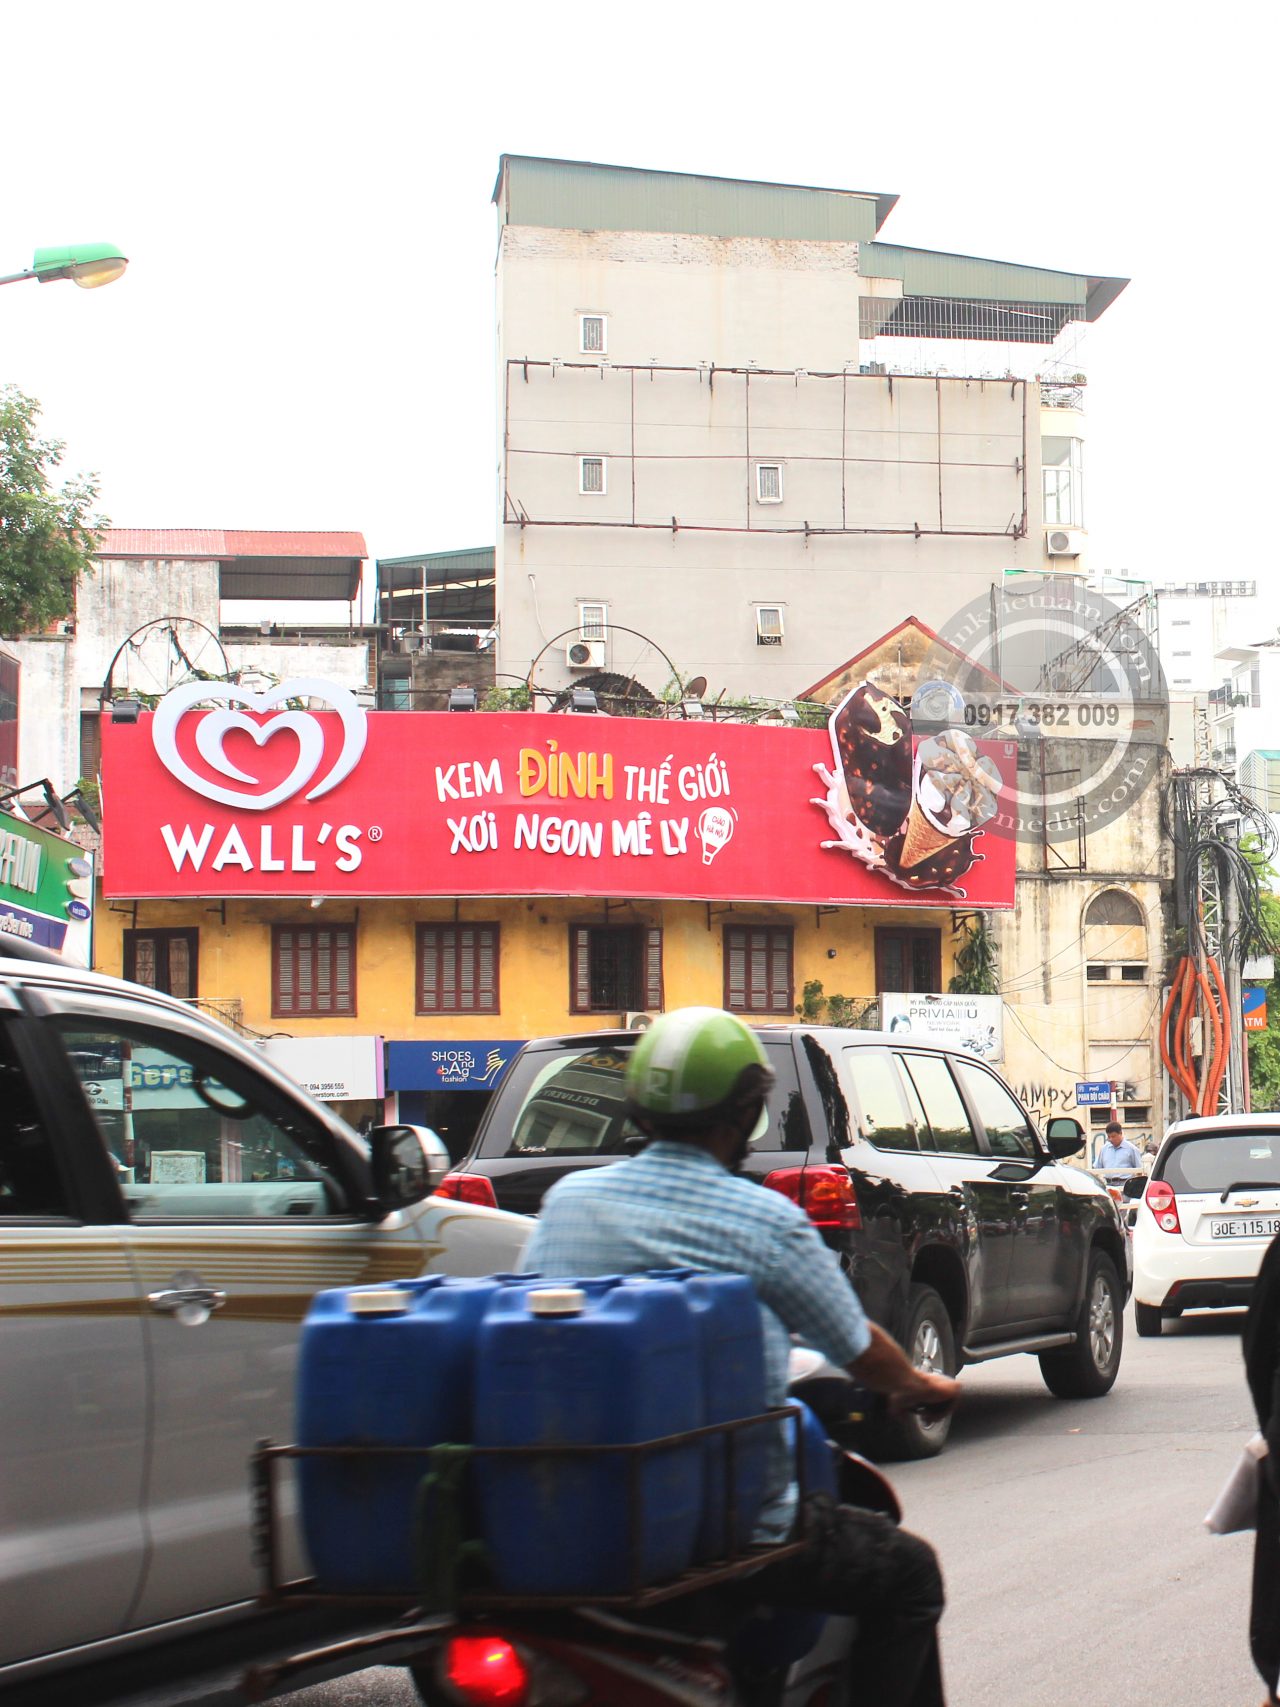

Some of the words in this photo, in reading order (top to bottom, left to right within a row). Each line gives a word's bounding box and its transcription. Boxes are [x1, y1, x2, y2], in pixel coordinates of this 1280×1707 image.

[435, 758, 504, 803] KEM
[516, 739, 613, 801] ĐỈNH
[623, 753, 675, 805] THẾ
[513, 813, 604, 859] NGON
[611, 811, 655, 857] MÊ
[659, 817, 690, 856] LY
[431, 1050, 472, 1062] SHOES
[441, 1075, 468, 1083] fashion
